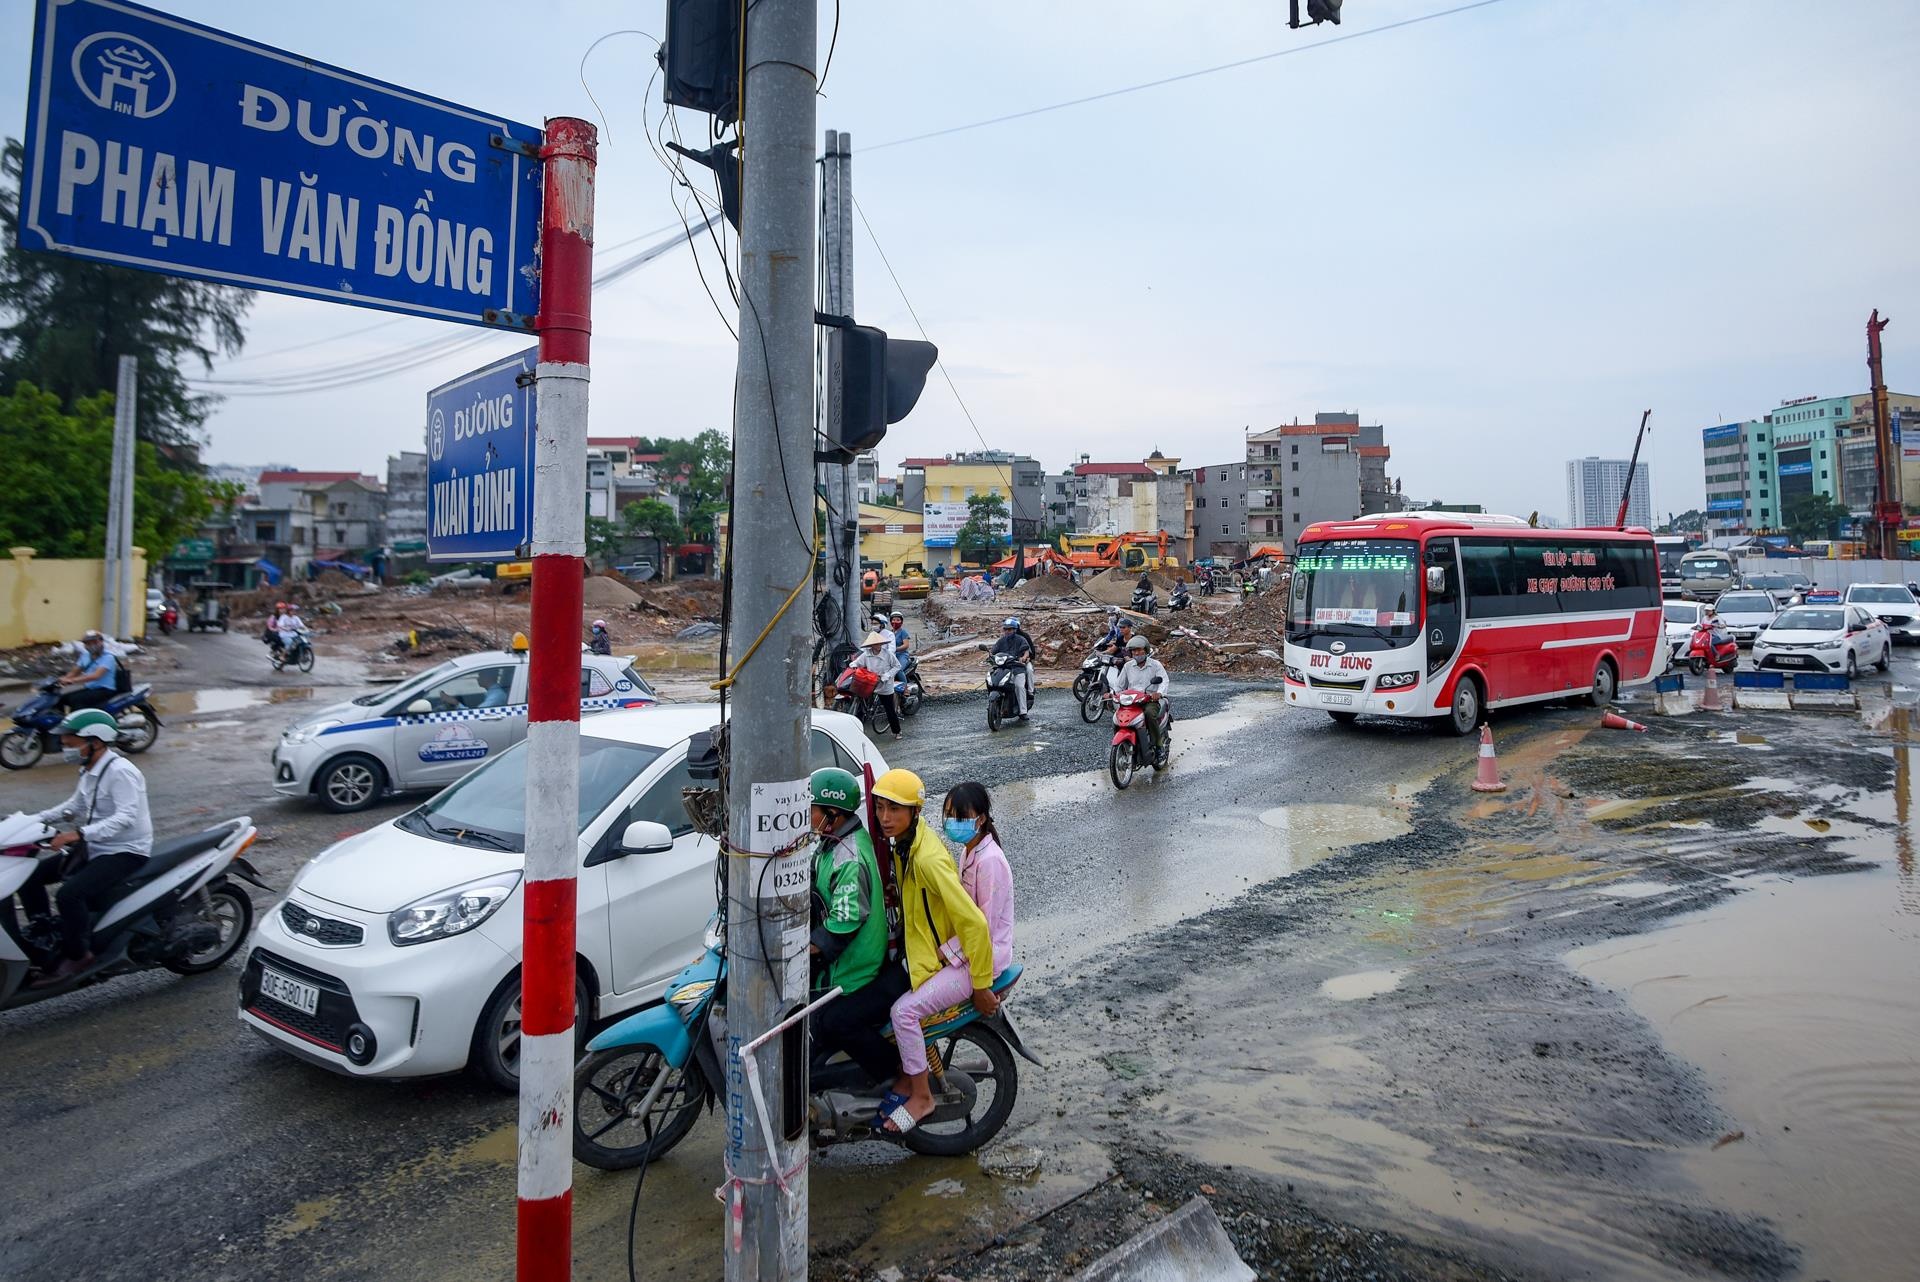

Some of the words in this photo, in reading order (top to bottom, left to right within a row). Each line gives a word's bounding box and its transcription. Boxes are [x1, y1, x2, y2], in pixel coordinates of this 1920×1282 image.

[114, 101, 132, 115] HN
[238, 83, 478, 184] ĐƯỜNG
[56, 130, 236, 247] PHẠM
[260, 171, 359, 271] VĂN
[373, 190, 493, 296] ĐỒNG
[454, 392, 513, 441] ĐƯỜNG
[433, 467, 469, 537] XUÂN
[473, 451, 515, 533] ĐỈNH
[1527, 578, 1537, 593] XE
[1310, 654, 1331, 667] HUY
[1340, 653, 1373, 670] HÙNG
[616, 682, 631, 690] 455
[775, 795, 791, 805] vay
[821, 789, 847, 800] Grab
[263, 971, 317, 1011] 30E-580.14
